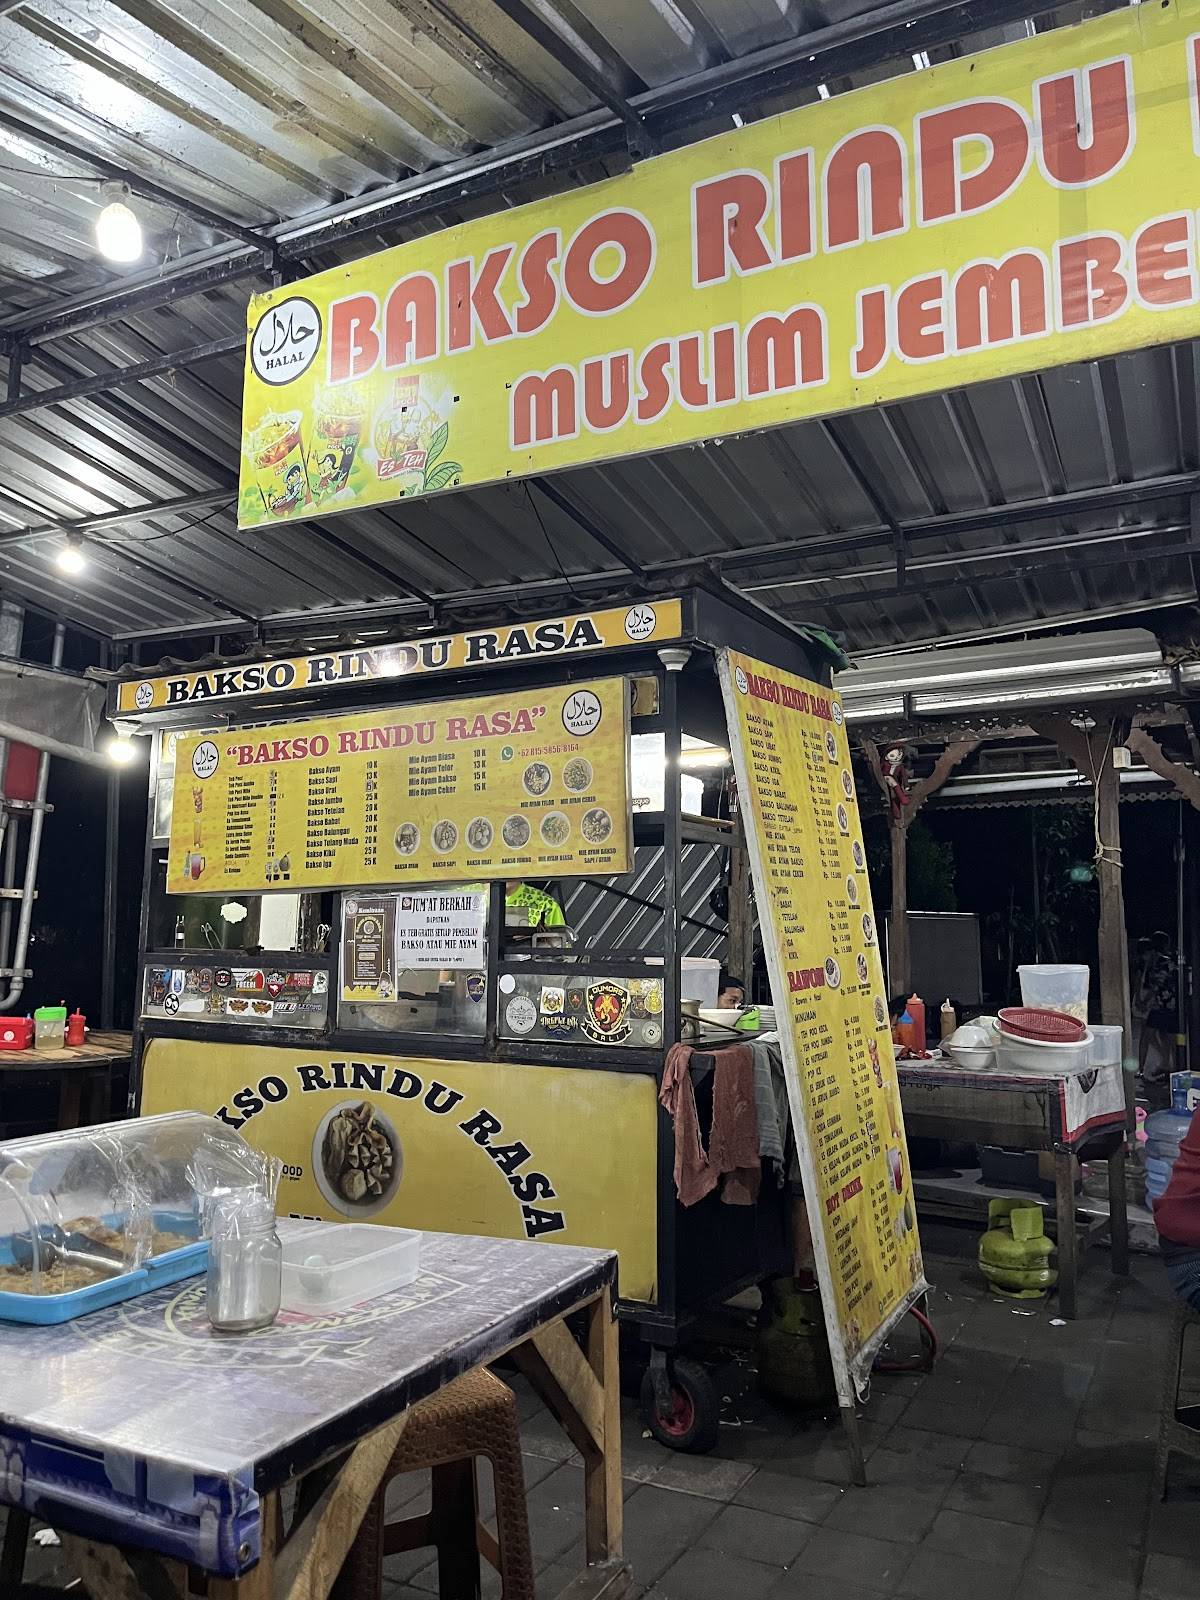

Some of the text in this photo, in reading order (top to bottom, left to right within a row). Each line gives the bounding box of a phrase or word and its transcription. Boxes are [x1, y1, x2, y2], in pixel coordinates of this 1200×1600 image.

[330, 206, 656, 384] BAKSO
[693, 54, 1135, 288] RINDU
[509, 208, 1200, 450] MUSLIM JEMBE
[266, 351, 306, 370] HALAL
[167, 619, 602, 704] BAKSO RINDU RASA
[745, 672, 779, 704] BAKSO
[571, 720, 594, 728] HALAL
[338, 721, 437, 753] RINDU
[473, 749, 481, 758] 10
[473, 760, 481, 769] 13
[309, 767, 324, 775] Bakso
[473, 772, 481, 780] 15
[308, 778, 324, 786] Bakso
[473, 783, 481, 791] 15
[308, 788, 324, 796] Bakso
[308, 798, 324, 806] Bakso
[307, 819, 323, 827] Bakso
[306, 850, 322, 858] Bakso
[439, 896, 472, 911] BERKAH
[408, 928, 417, 937] TEH
[418, 928, 434, 937] GRATIS
[401, 939, 424, 950] BAKSO
[425, 939, 443, 949] ATAU
[459, 939, 477, 949] AYAM
[592, 1032, 620, 1042] BALI
[214, 1062, 567, 1239] KSO RINDU RASA
[282, 1164, 303, 1176] OOD
